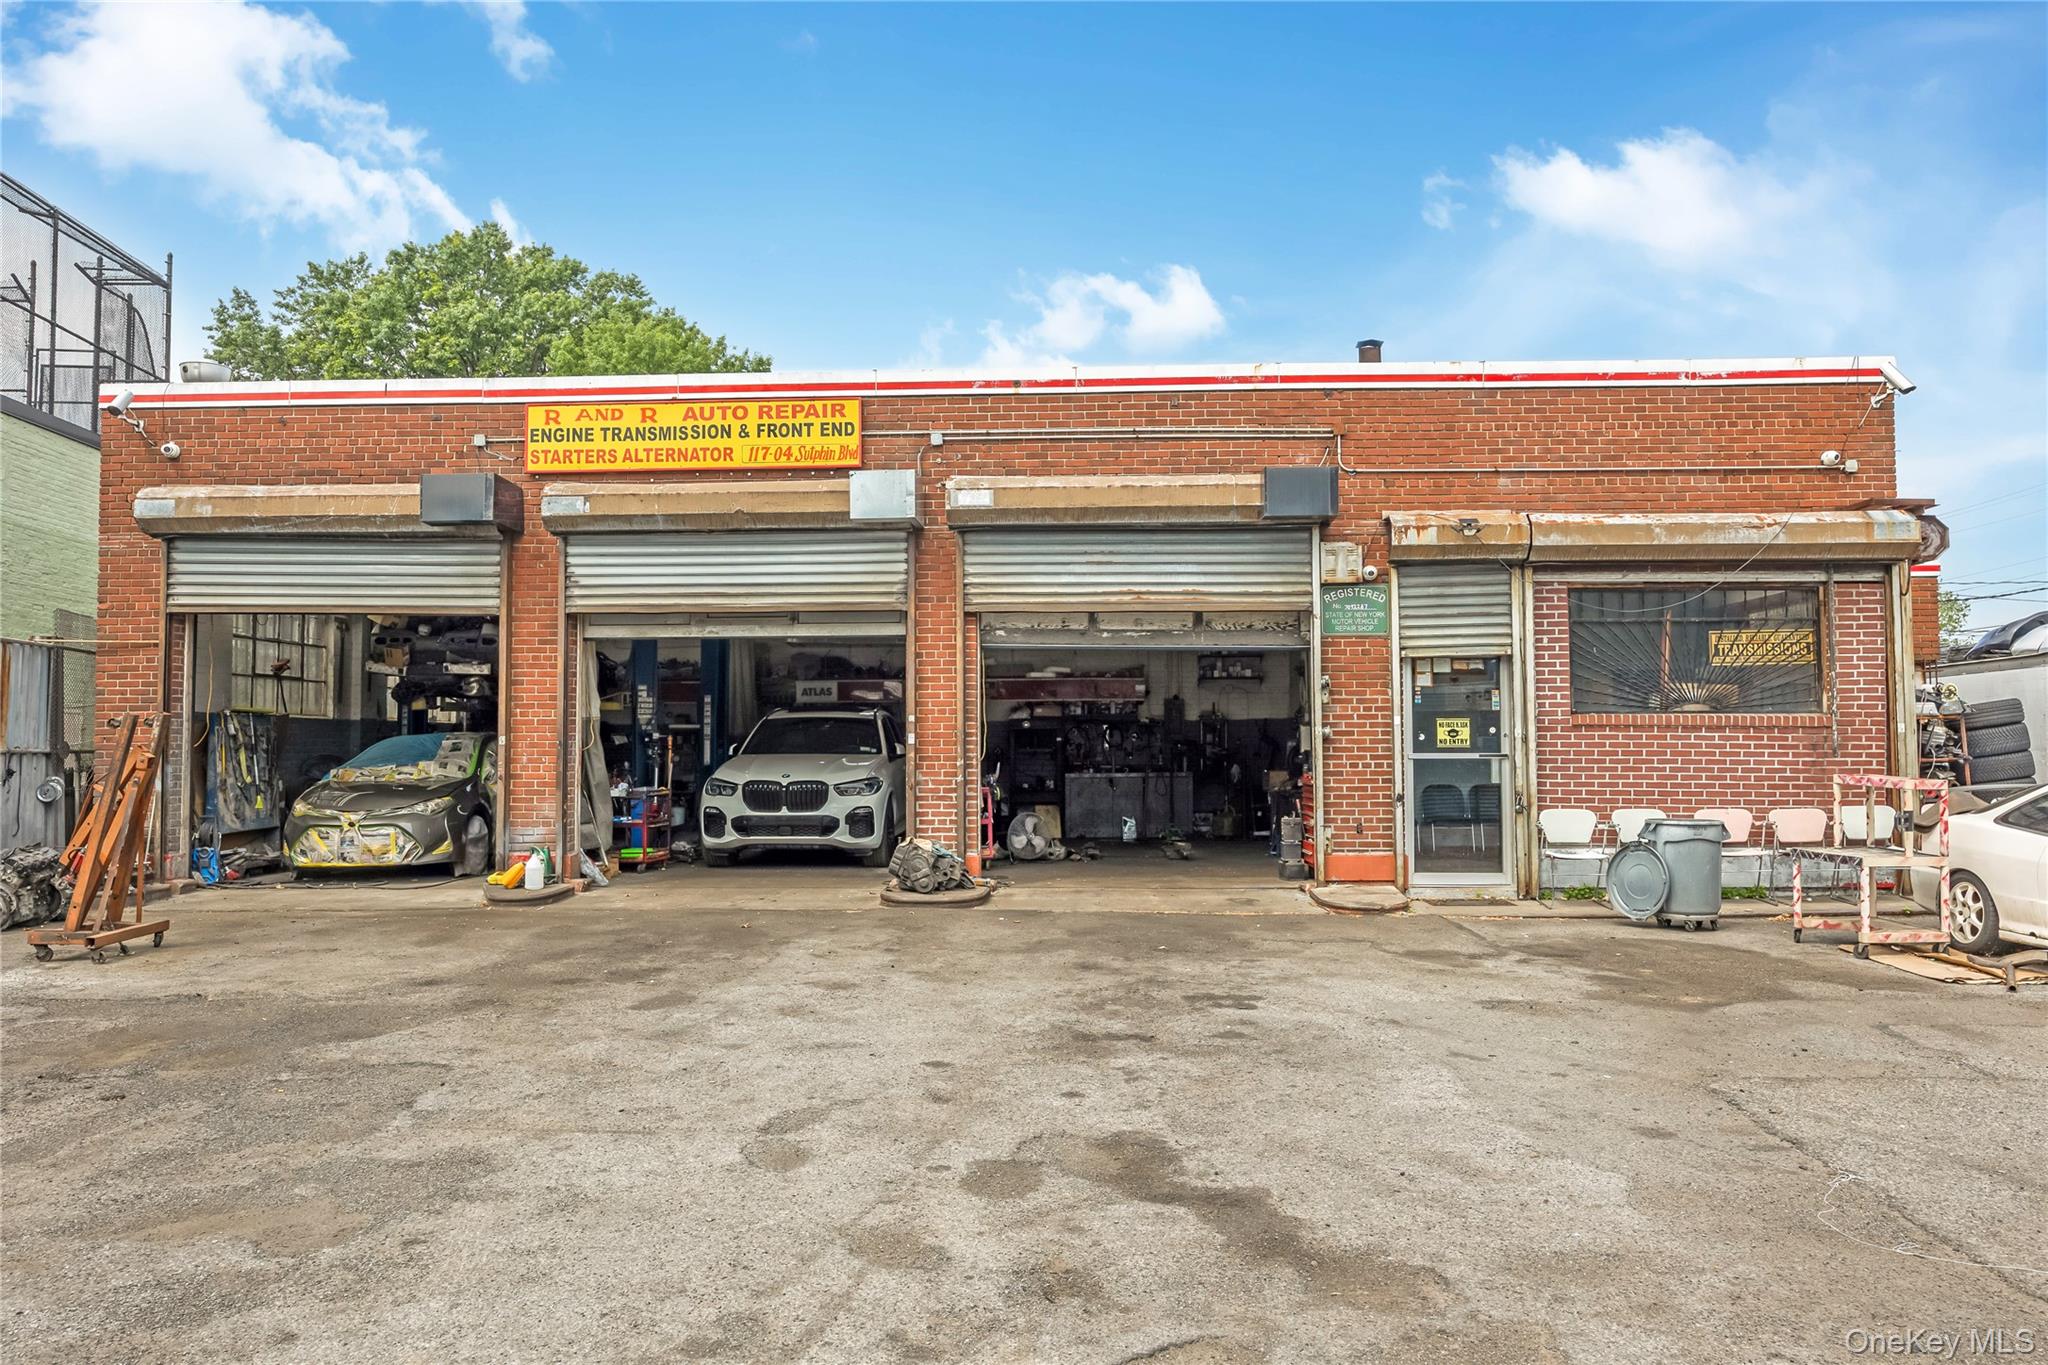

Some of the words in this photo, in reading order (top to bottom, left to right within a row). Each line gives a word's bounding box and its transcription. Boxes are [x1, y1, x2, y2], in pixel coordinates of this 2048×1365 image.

[544, 409, 561, 425] R
[575, 408, 624, 422] AND
[640, 407, 657, 423] R
[682, 405, 749, 421] AUTO
[758, 403, 846, 419] REPAIR
[530, 427, 594, 443] ENGINE
[600, 424, 732, 442] TRANSMISSION
[738, 424, 750, 438] &
[756, 423, 814, 438] FRONT
[820, 421, 855, 437] END
[530, 448, 618, 464] STARTERS
[622, 447, 734, 463] ALTERNATOR
[748, 445, 793, 462] 117-04
[795, 444, 835, 464] Sutphin
[838, 444, 858, 461] Blvd
[1323, 588, 1386, 603] REGISTERED
[1718, 642, 1808, 656] TRANSMISSIONS
[801, 687, 832, 697] ATLAS
